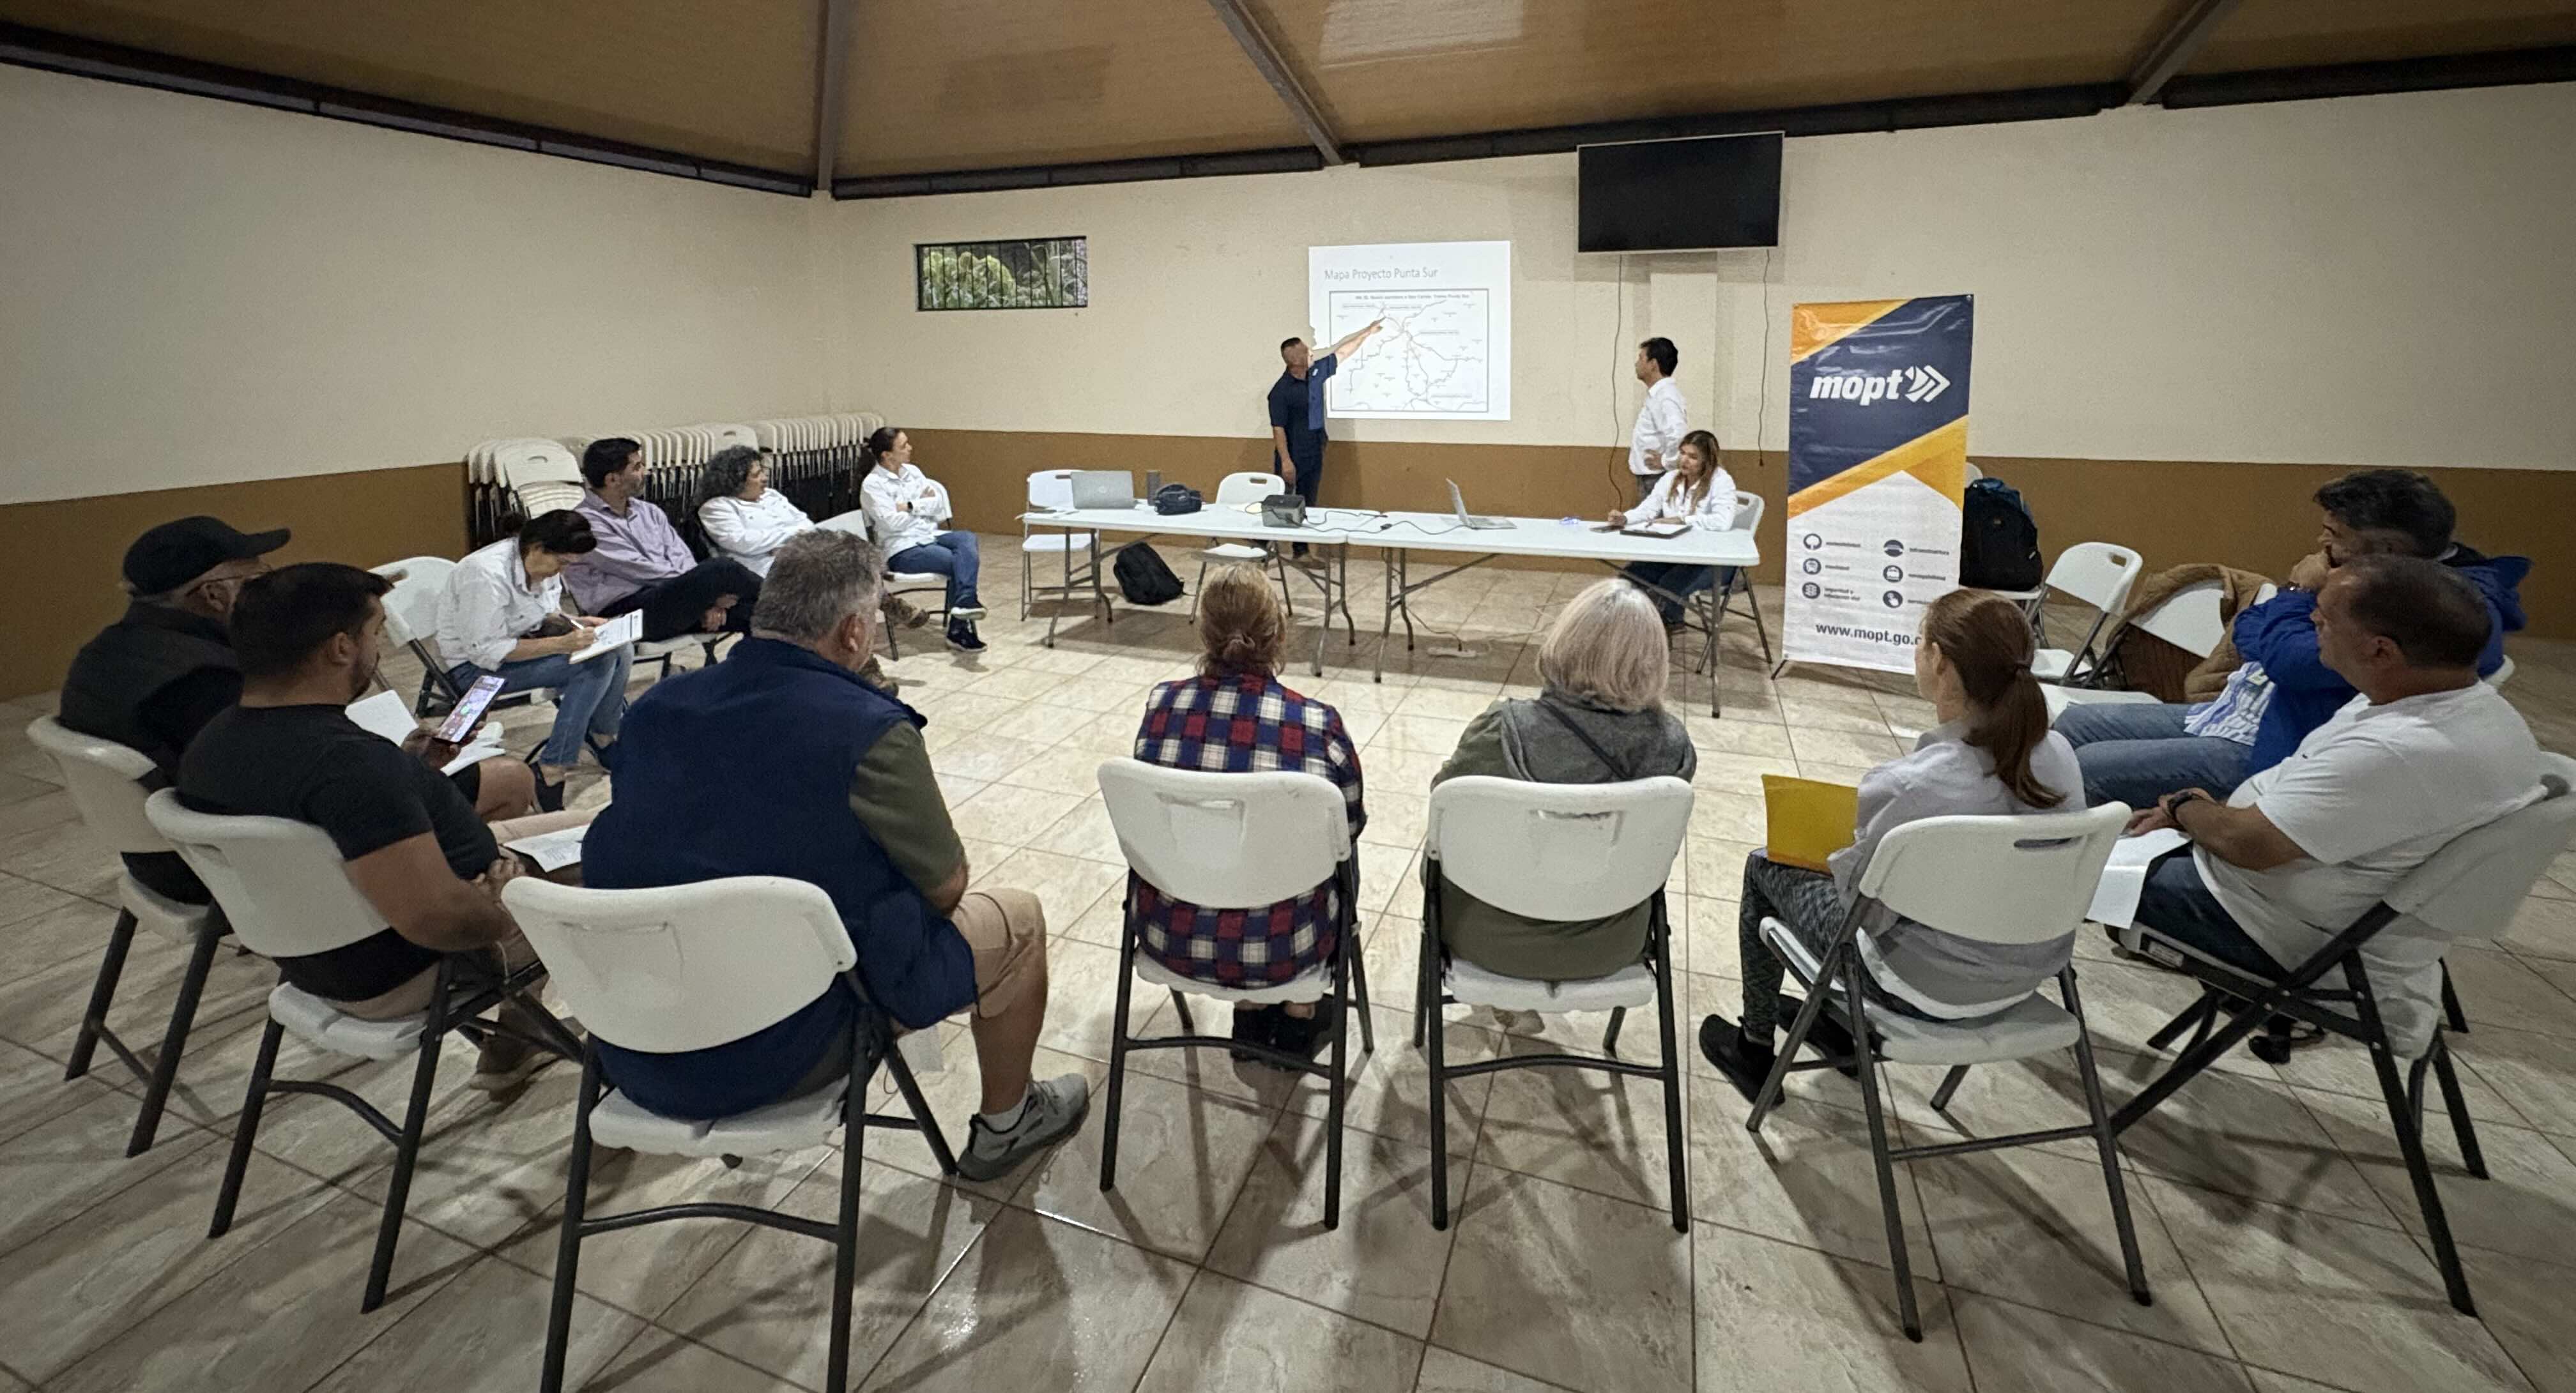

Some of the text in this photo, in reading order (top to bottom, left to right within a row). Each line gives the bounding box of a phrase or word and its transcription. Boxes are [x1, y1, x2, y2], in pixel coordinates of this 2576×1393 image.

[1324, 266, 1438, 281] Mapa Proyecto Punta Sur
[1809, 369, 1903, 406] mopt
[1816, 623, 1922, 646] www.mopt.go.c
